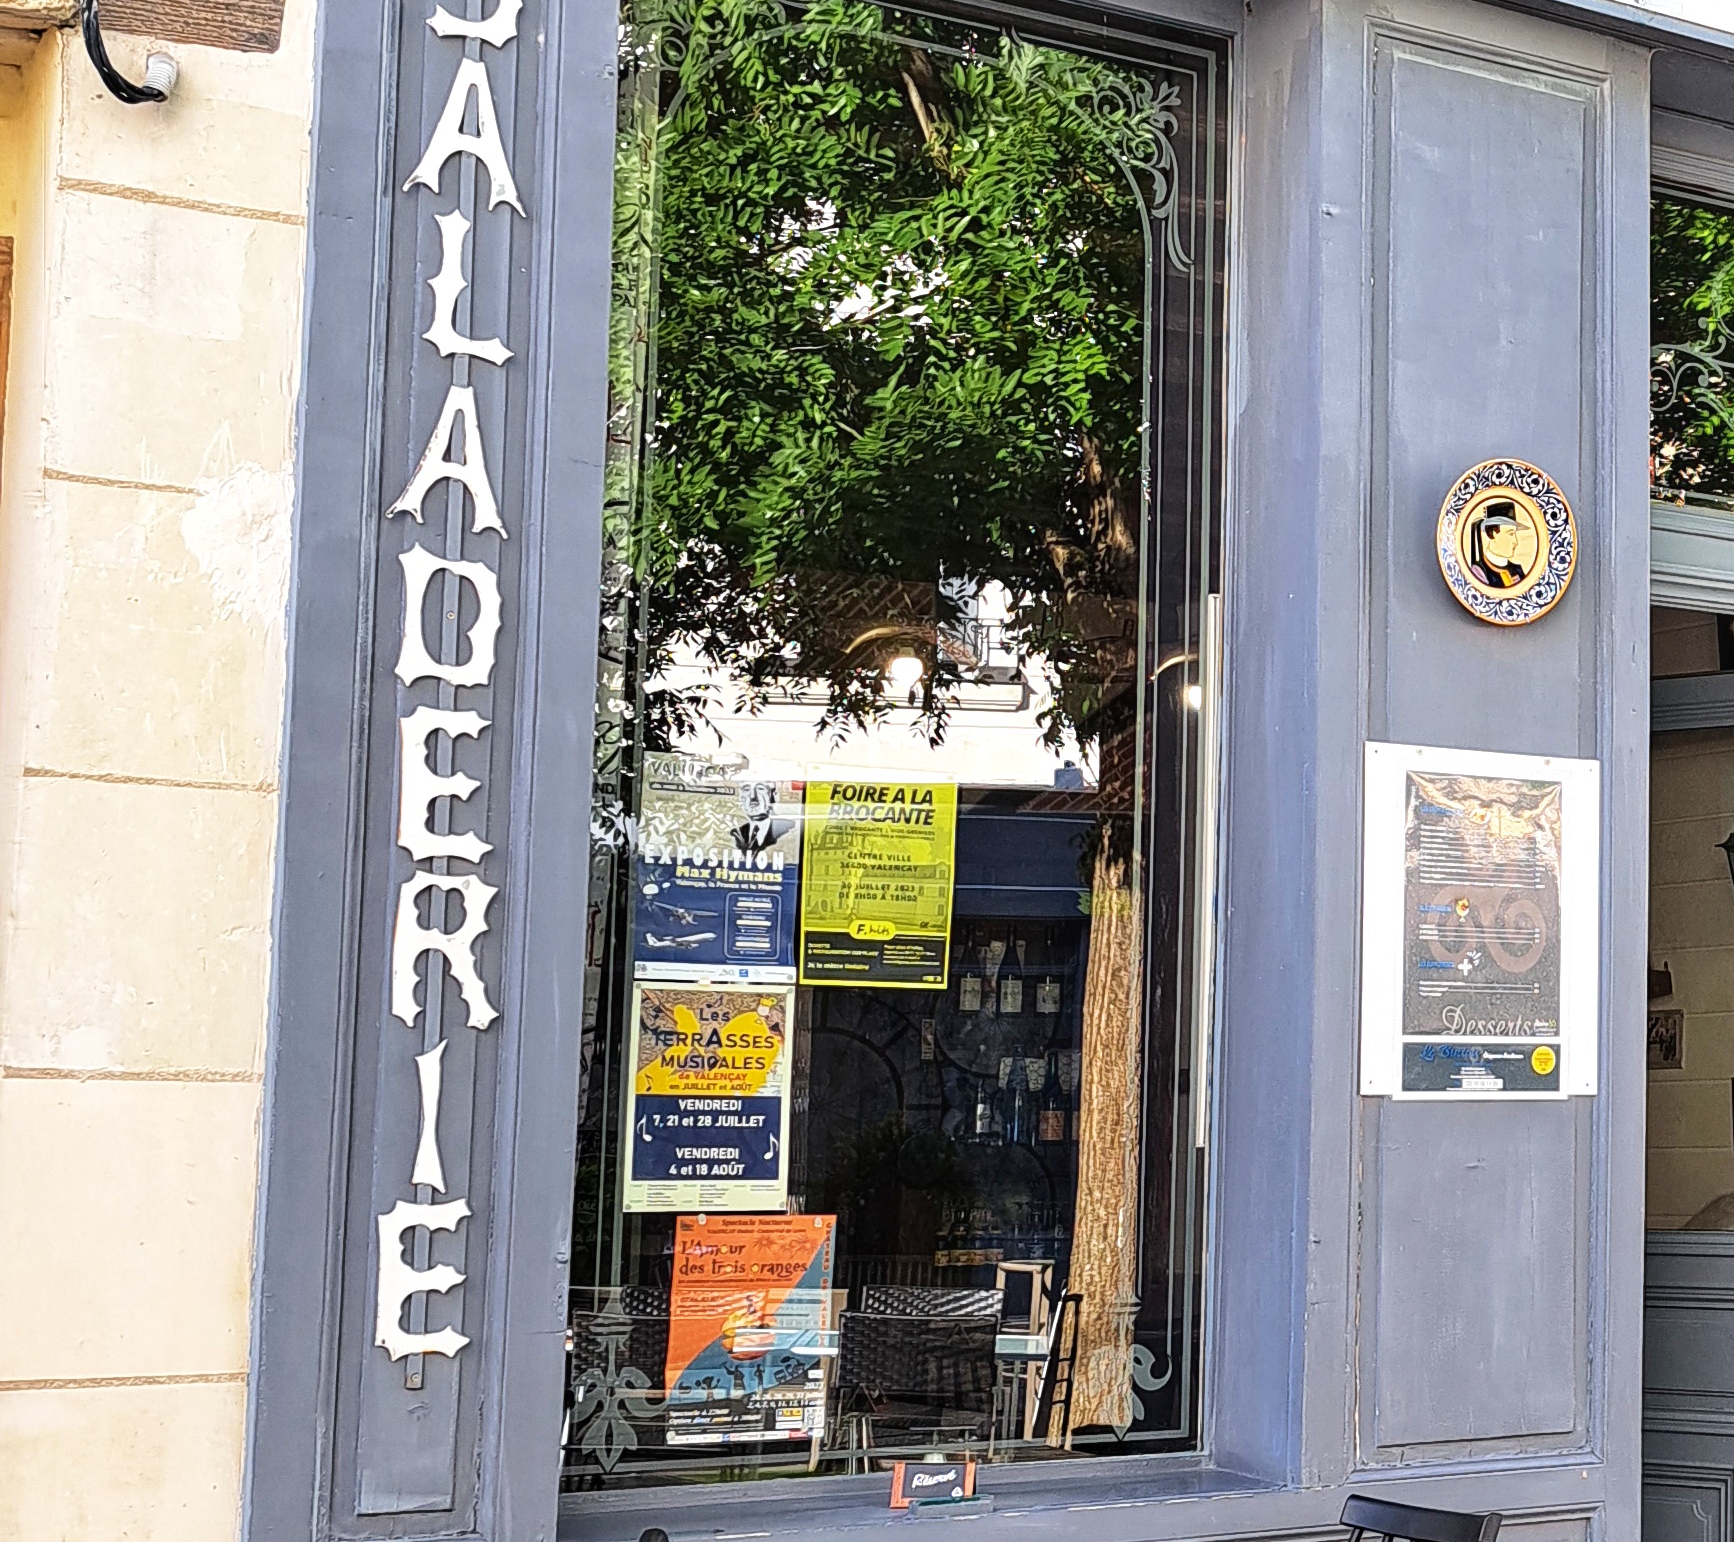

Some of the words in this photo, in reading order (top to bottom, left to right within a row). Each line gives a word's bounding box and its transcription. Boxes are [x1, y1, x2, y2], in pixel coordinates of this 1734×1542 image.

[830, 784, 890, 803] FOIRE
[889, 788, 905, 804] A
[911, 790, 933, 805] LA
[828, 803, 936, 826] BROCANTE
[645, 844, 784, 870] EXPOSITION
[847, 852, 882, 861] CENTRE
[676, 865, 711, 879] Max
[715, 867, 783, 883] Hymans
[855, 882, 891, 891] JUILLET
[700, 1008, 730, 1021] Les
[1442, 1004, 1532, 1036] Desserts
[655, 1028, 775, 1049] TERRASSES
[660, 1055, 766, 1070] MUSICALES
[678, 1072, 690, 1080] de
[694, 1072, 748, 1083] VALENÇAY
[730, 1082, 753, 1091] AOÛT
[679, 1099, 742, 1111] VENDREDI
[653, 1115, 664, 1129] 7,
[667, 1115, 678, 1126] 21
[682, 1115, 694, 1126] et
[697, 1115, 712, 1126] 28
[715, 1115, 766, 1127] JUILLET
[676, 1147, 740, 1160] VENDREDI
[669, 1164, 677, 1175] 4
[681, 1164, 693, 1175] et
[696, 1164, 707, 1175] 18
[711, 1161, 745, 1176] AOÛT
[679, 1257, 705, 1276] des
[711, 1259, 746, 1276] trois
[752, 1261, 808, 1278] oranges
